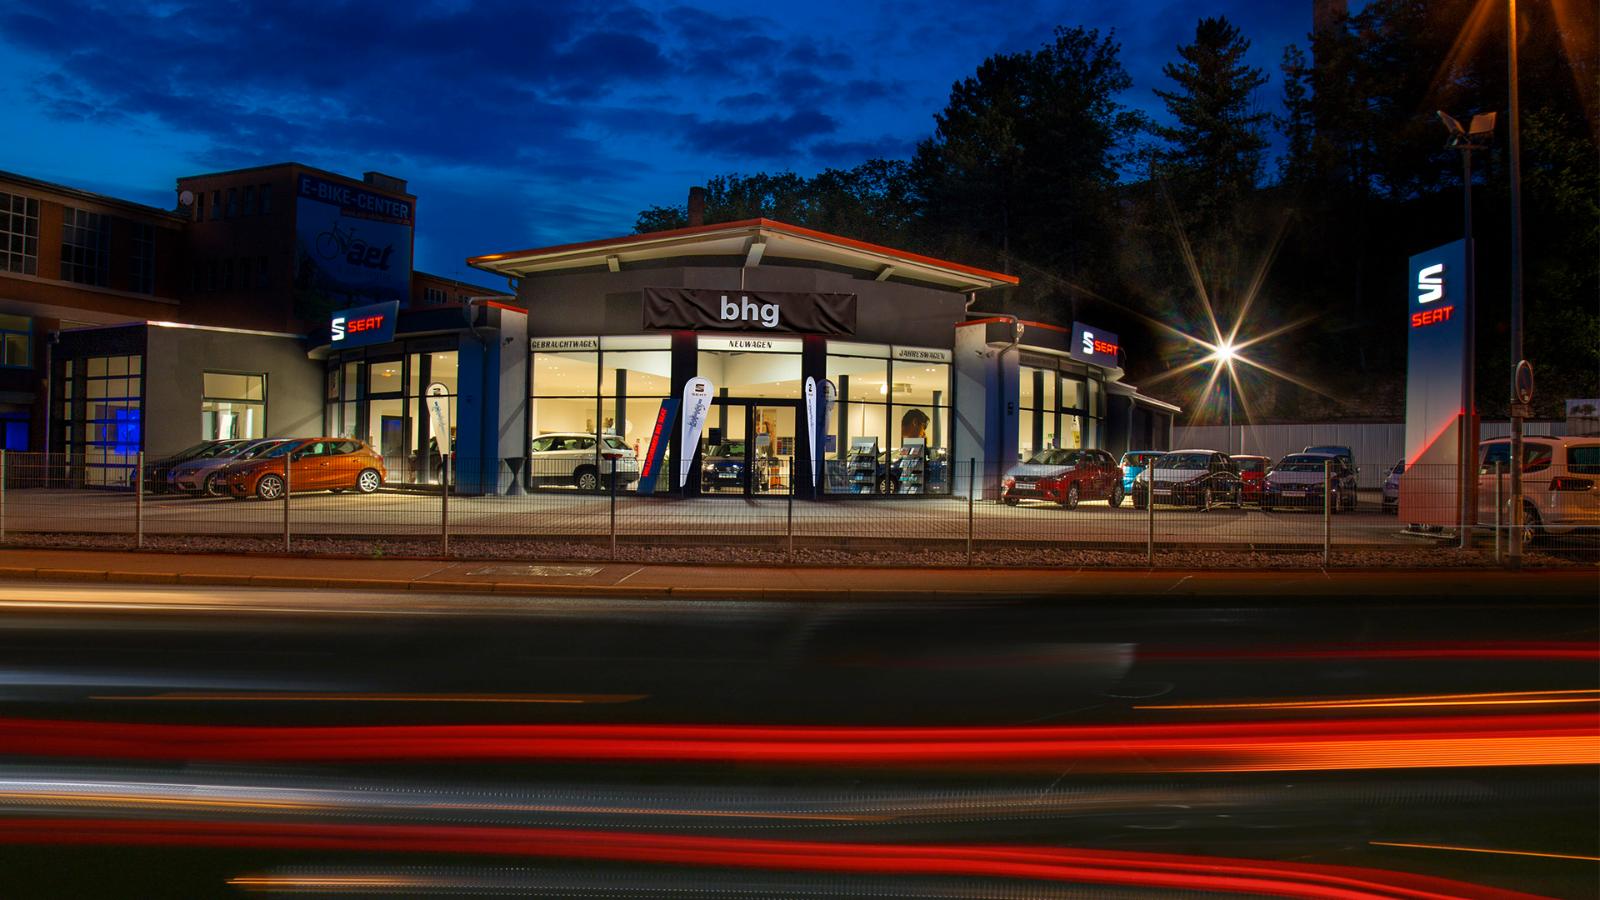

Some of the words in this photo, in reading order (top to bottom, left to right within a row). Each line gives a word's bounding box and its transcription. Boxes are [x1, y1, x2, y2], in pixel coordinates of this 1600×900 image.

[302, 178, 409, 218] E-BIKE-CENTER
[720, 295, 780, 328] bhg
[1411, 304, 1454, 327] SEAT
[348, 315, 384, 333] SEAT
[531, 339, 598, 349] GEBRAUCHTWAGEN
[728, 340, 773, 349] NEUWAGEN
[1094, 339, 1118, 356] SEAT
[898, 349, 946, 361] JAHRESWAGEN
